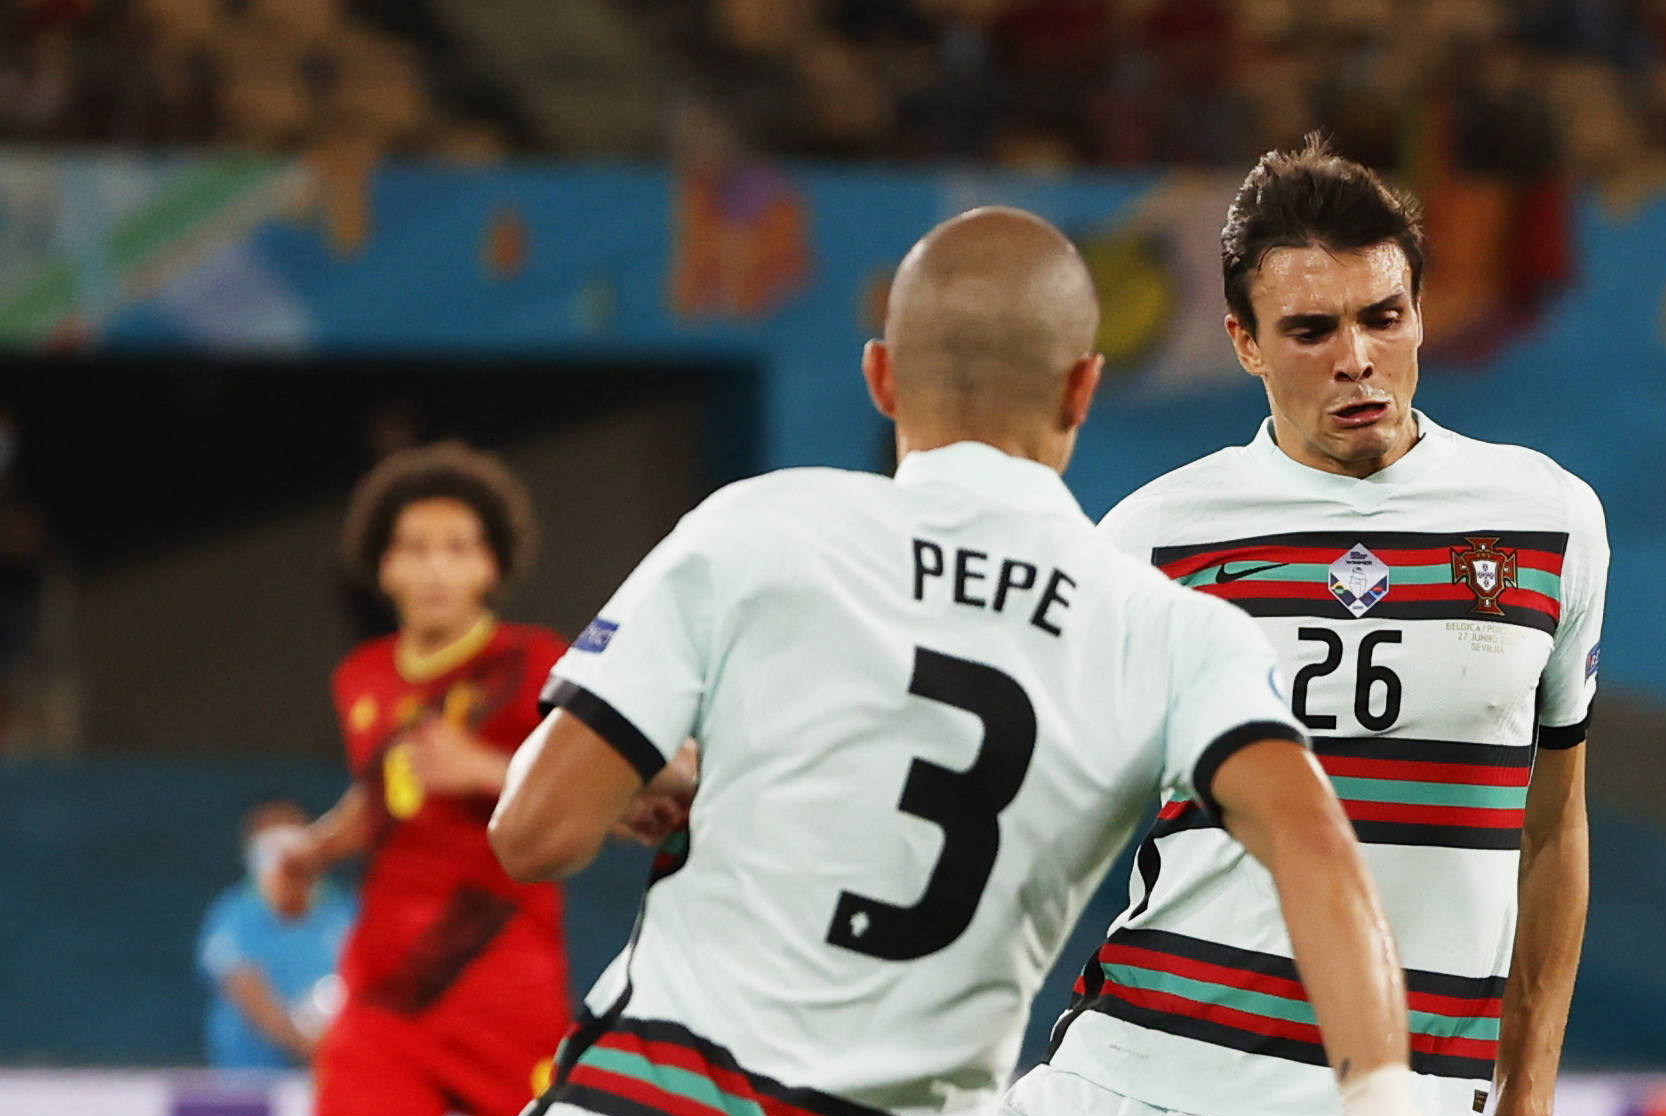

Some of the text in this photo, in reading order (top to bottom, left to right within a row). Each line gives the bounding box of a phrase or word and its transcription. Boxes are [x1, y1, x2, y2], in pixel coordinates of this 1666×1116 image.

[912, 538, 1077, 638] PEPE
[1292, 627, 1403, 732] 26
[826, 645, 1038, 961] 3
